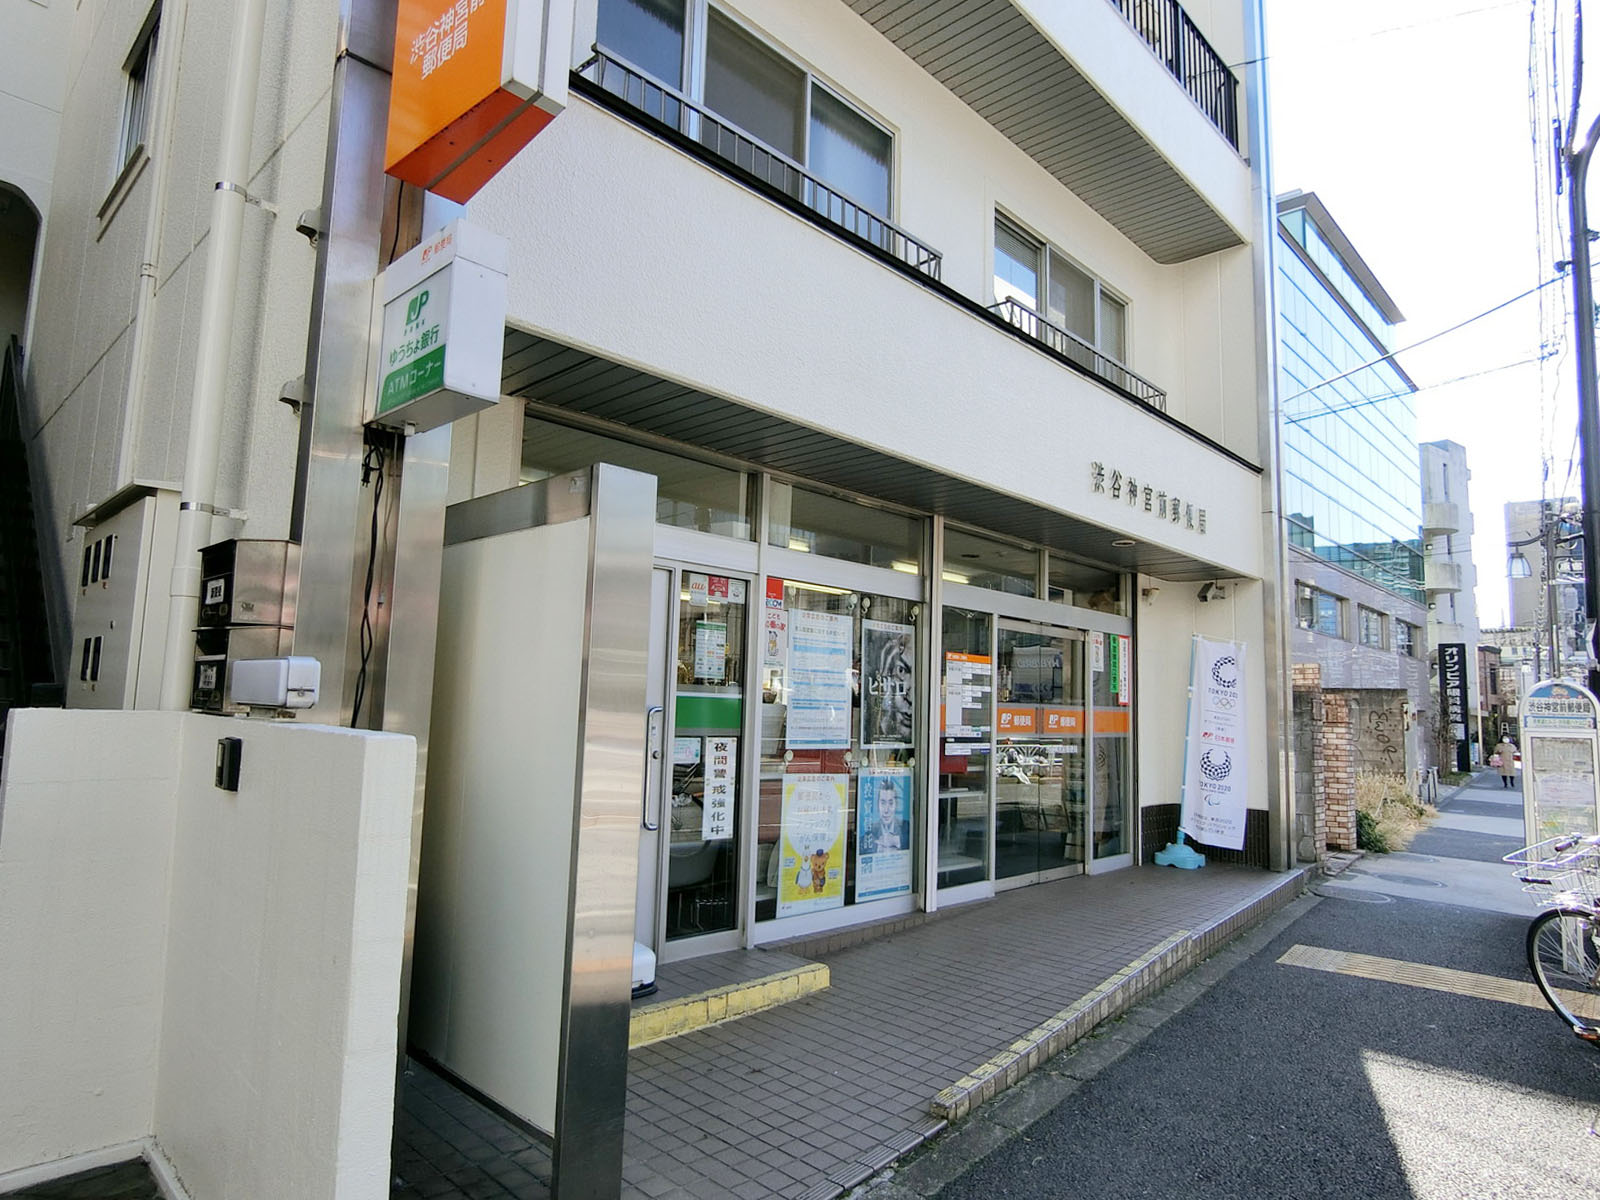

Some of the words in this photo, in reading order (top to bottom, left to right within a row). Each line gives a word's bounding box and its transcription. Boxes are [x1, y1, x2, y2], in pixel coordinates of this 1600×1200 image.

[421, 20, 469, 81] 郵便局
[388, 323, 441, 368] ゆうちょ銀行
[386, 359, 442, 395] ATMコーナー
[1091, 461, 1207, 535] 渋谷神宮前郵便局
[691, 582, 705, 591] au
[1528, 700, 1591, 713] 渋谷神宮前郵便局
[710, 742, 729, 835] 夜間警戒強化中
[1199, 780, 1217, 790] OKYO
